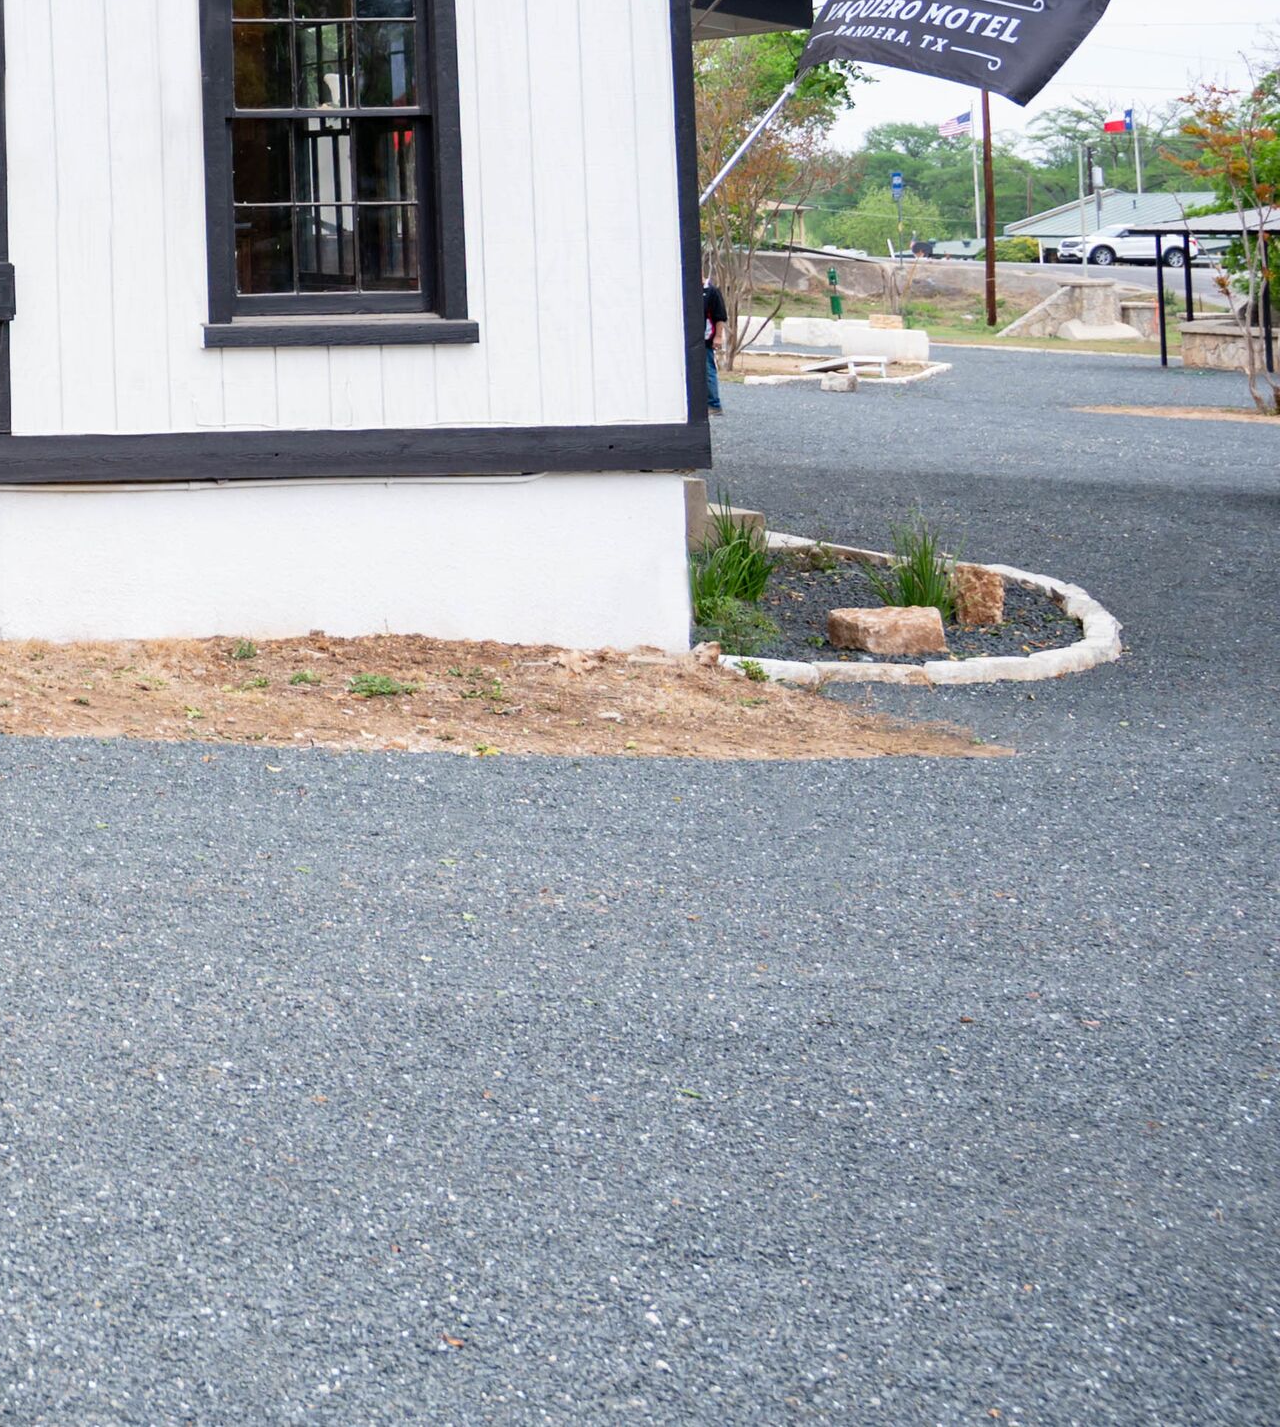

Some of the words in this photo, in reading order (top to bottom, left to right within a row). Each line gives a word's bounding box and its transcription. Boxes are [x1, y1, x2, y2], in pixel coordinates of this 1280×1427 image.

[824, 0, 922, 23] VAQUERO
[919, 3, 1021, 44] MOTEL
[834, 25, 912, 47] BANDERA,
[919, 35, 949, 53] TX
